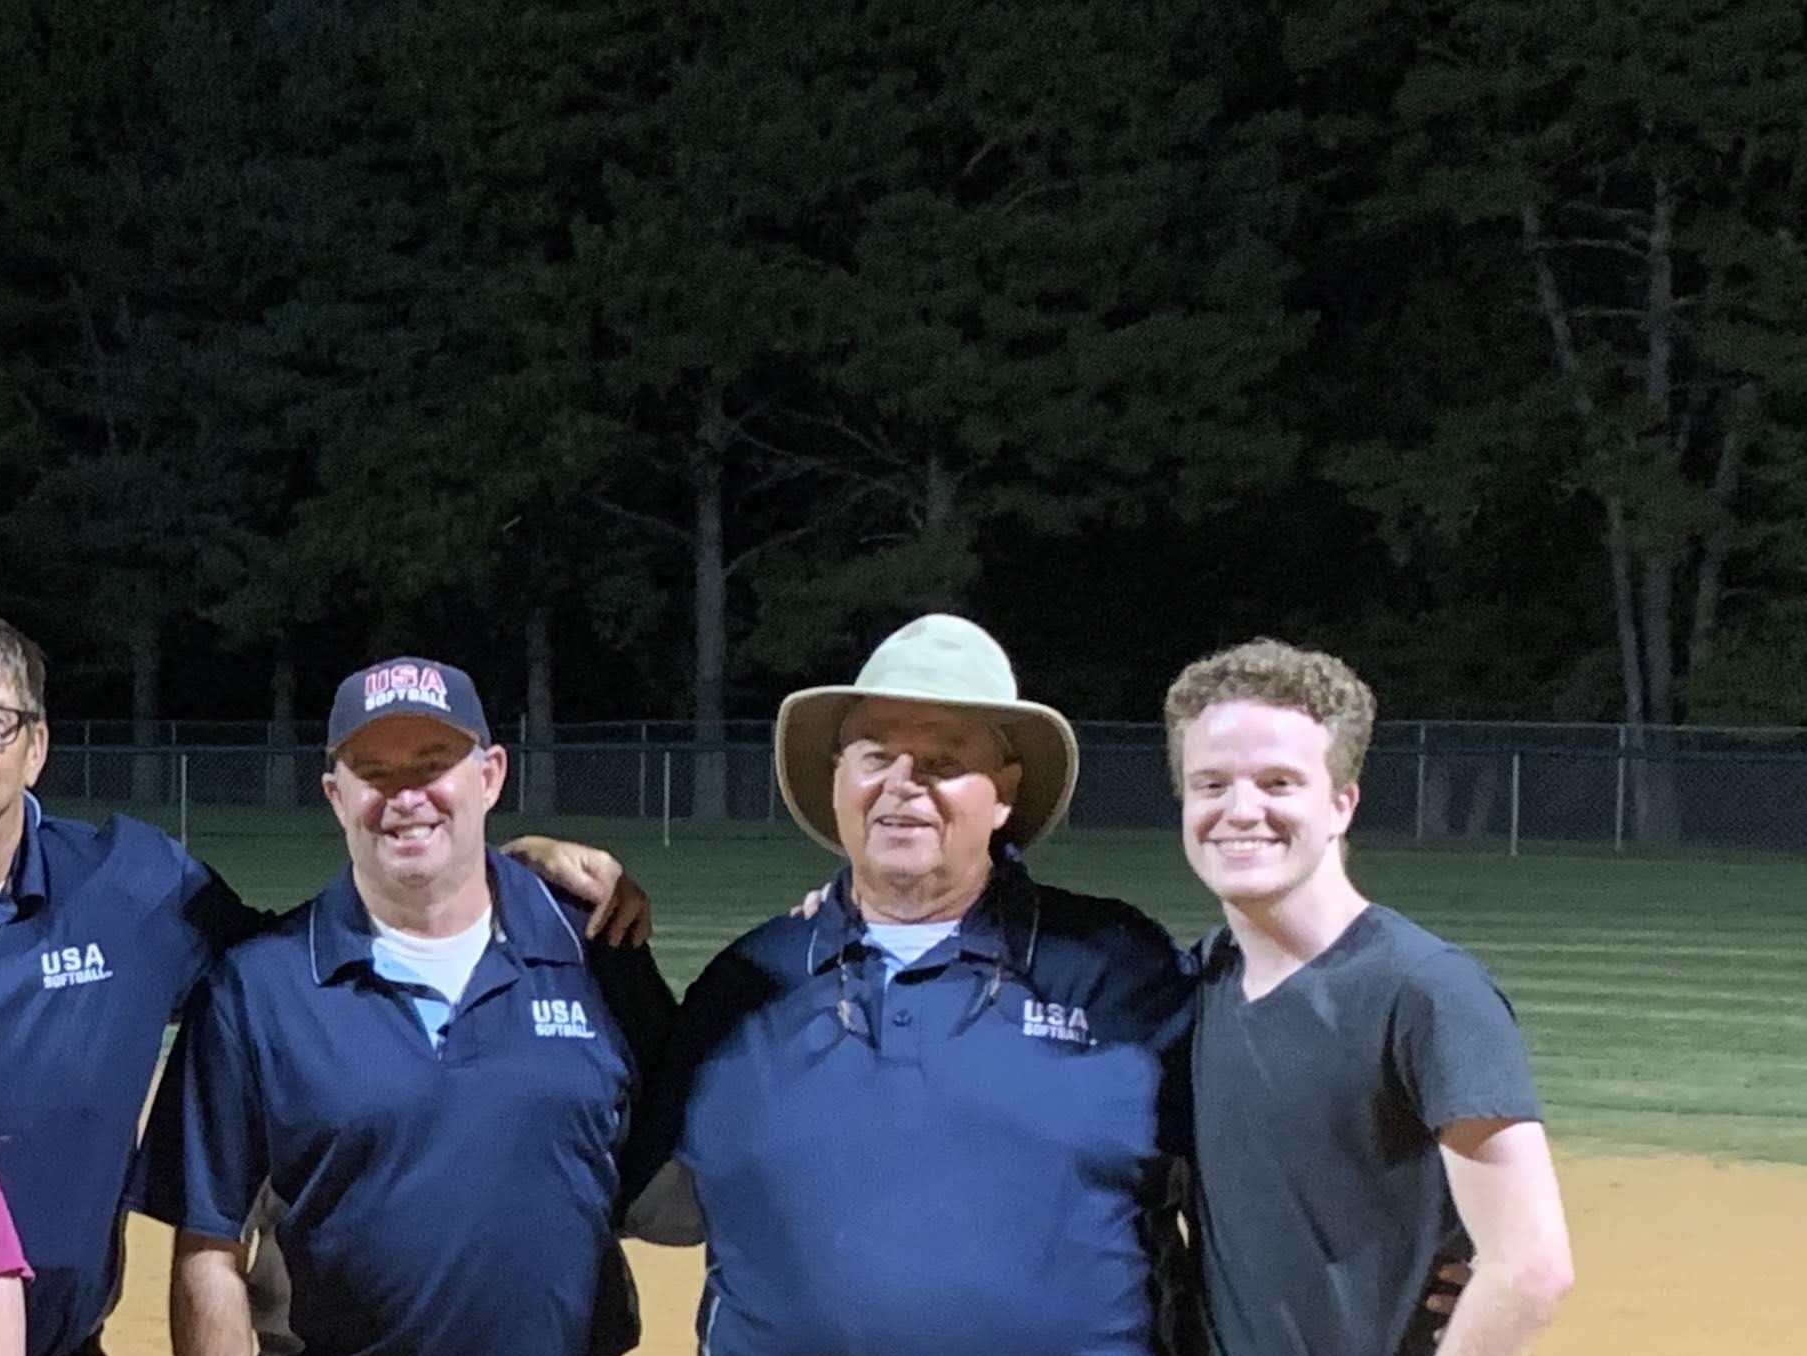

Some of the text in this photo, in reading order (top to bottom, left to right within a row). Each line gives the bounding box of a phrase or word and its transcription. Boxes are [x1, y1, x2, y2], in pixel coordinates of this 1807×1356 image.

[364, 664, 449, 696] USA
[364, 688, 452, 713] SOFTBALL
[41, 943, 105, 976] USA
[43, 967, 107, 989] SOFTBALL
[532, 999, 588, 1024] USA
[1023, 999, 1089, 1031] USA
[534, 1021, 591, 1038] SOFTBALL
